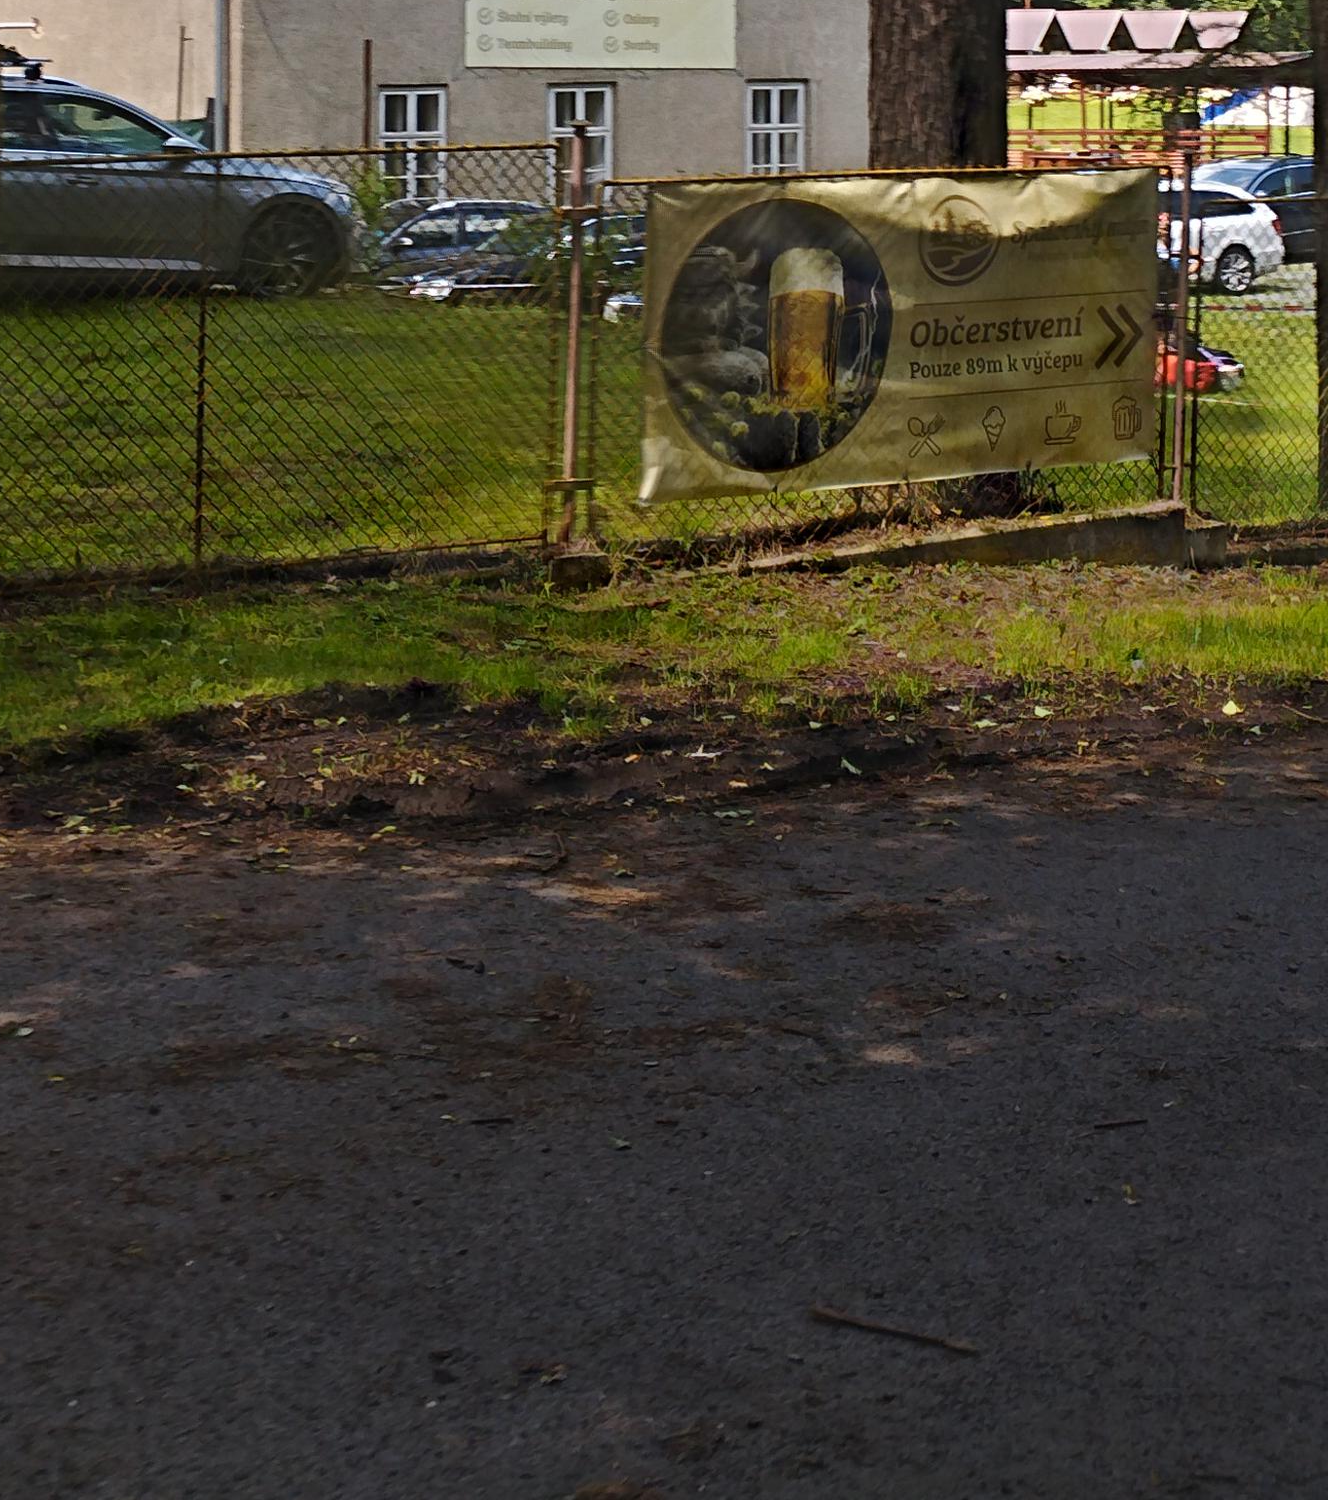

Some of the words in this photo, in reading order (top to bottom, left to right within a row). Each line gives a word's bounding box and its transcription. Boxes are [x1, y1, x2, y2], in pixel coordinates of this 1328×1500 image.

[910, 306, 1085, 348] Občerstvení
[909, 360, 961, 379] Pouze
[966, 356, 1003, 374] 89m
[1008, 354, 1018, 372] k
[1023, 351, 1084, 375] výčepu
